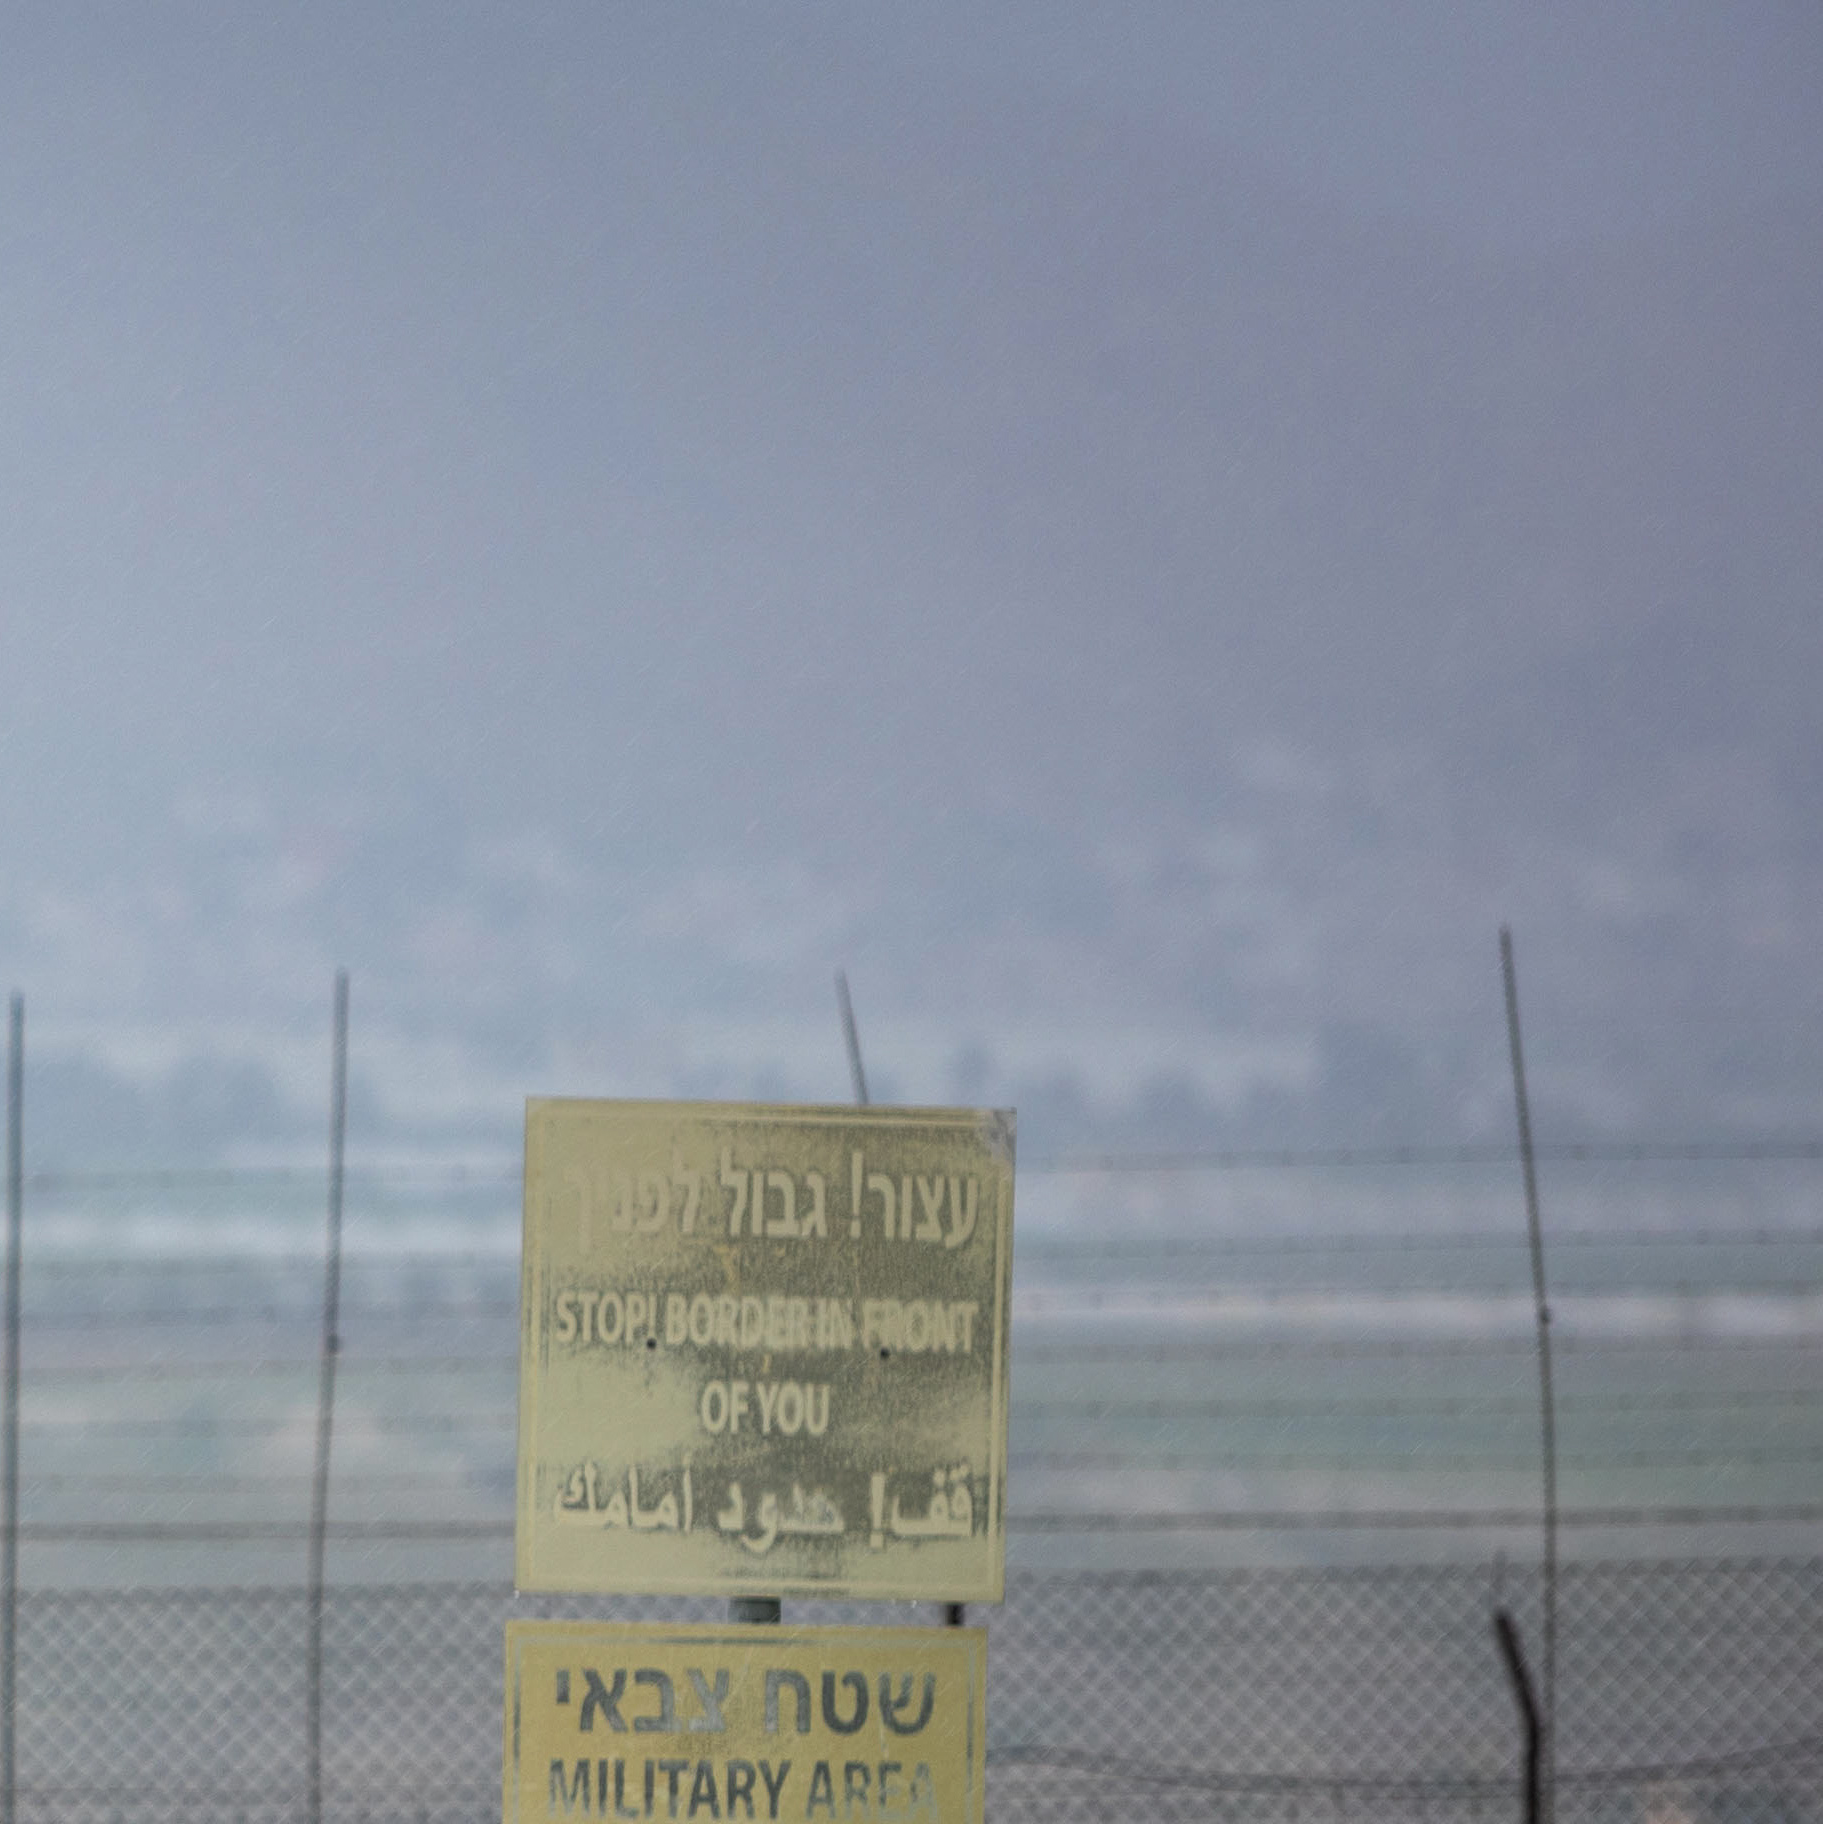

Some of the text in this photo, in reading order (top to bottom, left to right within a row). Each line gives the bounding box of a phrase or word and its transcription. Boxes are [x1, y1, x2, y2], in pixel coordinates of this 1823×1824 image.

[564, 1145, 979, 1254] עצור! גבול לפניך
[556, 1292, 978, 1353] STOP! BORDER IN FRONT
[702, 1380, 832, 1437] OF YOU
[716, 1480, 845, 1553] حدود
[554, 1668, 937, 1736] שטח צבאי
[548, 1758, 939, 1824] MILITARY AREA
